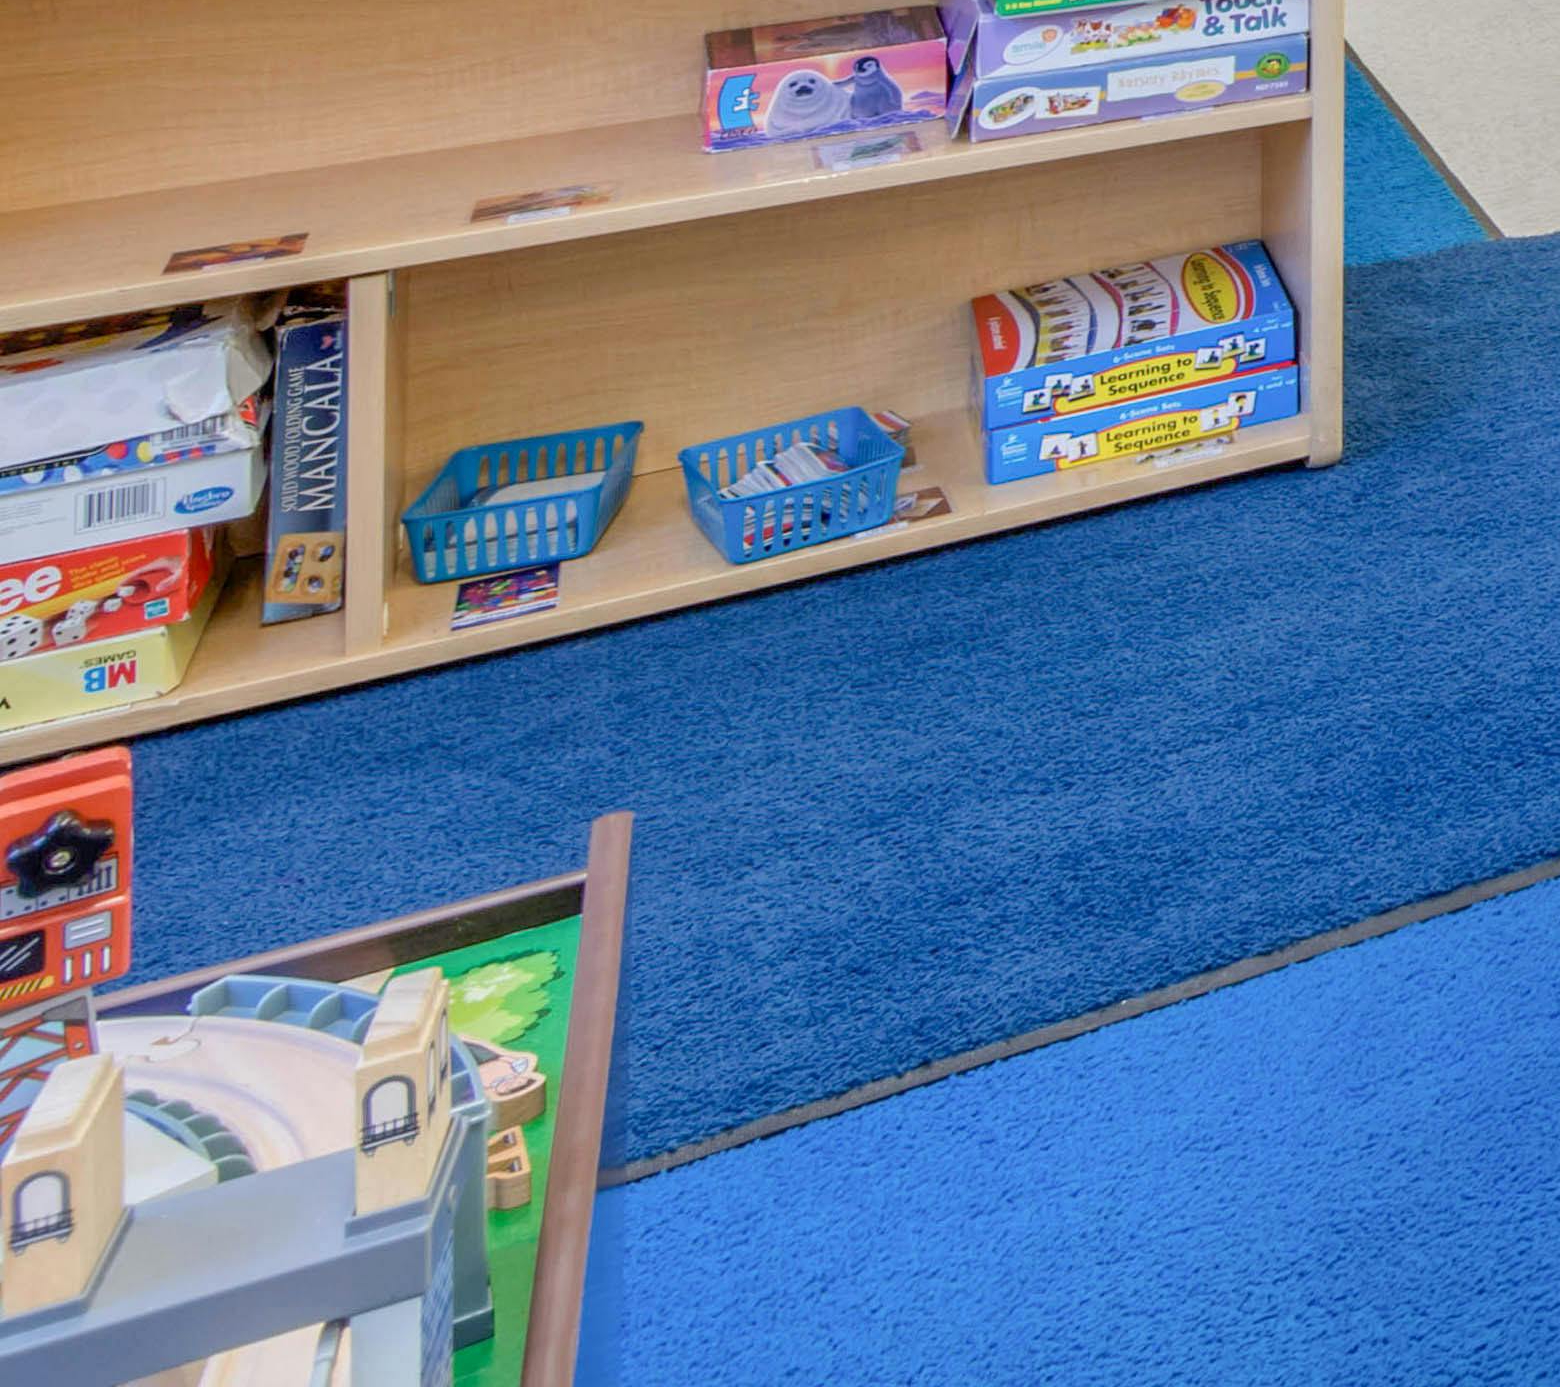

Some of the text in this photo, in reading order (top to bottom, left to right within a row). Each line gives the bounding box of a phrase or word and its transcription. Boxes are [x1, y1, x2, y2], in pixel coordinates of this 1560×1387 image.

[1202, 6, 1288, 37] & Talk
[1100, 356, 1193, 386] Learning to
[1108, 370, 1186, 396] Sequence
[281, 367, 306, 514] SOLID WOOD FOLDING GAME
[298, 352, 344, 513] MANCALA
[1105, 413, 1198, 442] Learning to
[1113, 428, 1191, 453] Sequence
[84, 661, 137, 694] MB
